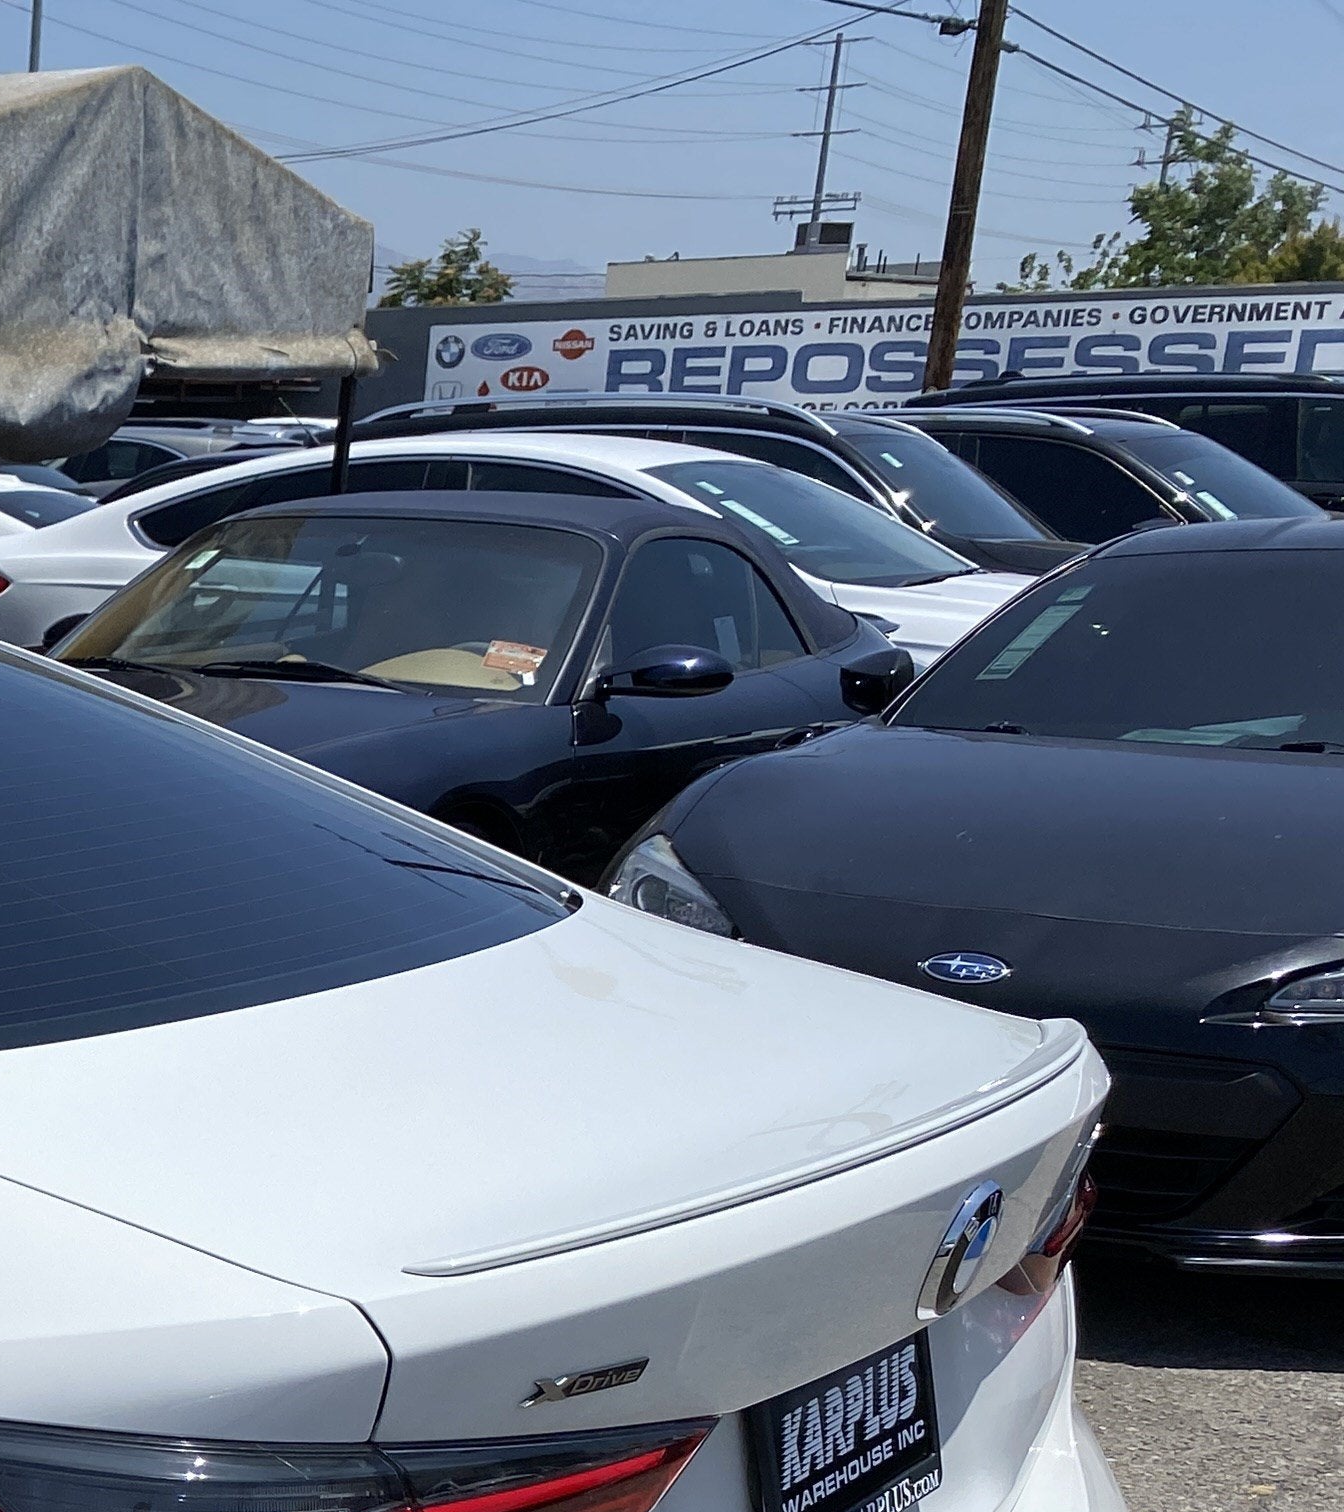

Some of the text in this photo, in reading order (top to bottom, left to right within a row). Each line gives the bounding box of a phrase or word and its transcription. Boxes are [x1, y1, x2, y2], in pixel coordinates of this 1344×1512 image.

[608, 320, 694, 342] SAVING
[703, 318, 718, 338] &
[724, 317, 804, 338] LOANS
[827, 313, 934, 335] FINANCE
[957, 307, 1102, 332] OMPANIES
[1127, 300, 1332, 325] GOVERNMENT
[483, 339, 519, 355] Ford
[554, 339, 593, 351] NISSAN
[507, 371, 544, 388] KIA
[780, 1344, 917, 1491] KARPLUS
[898, 1419, 925, 1451] INC
